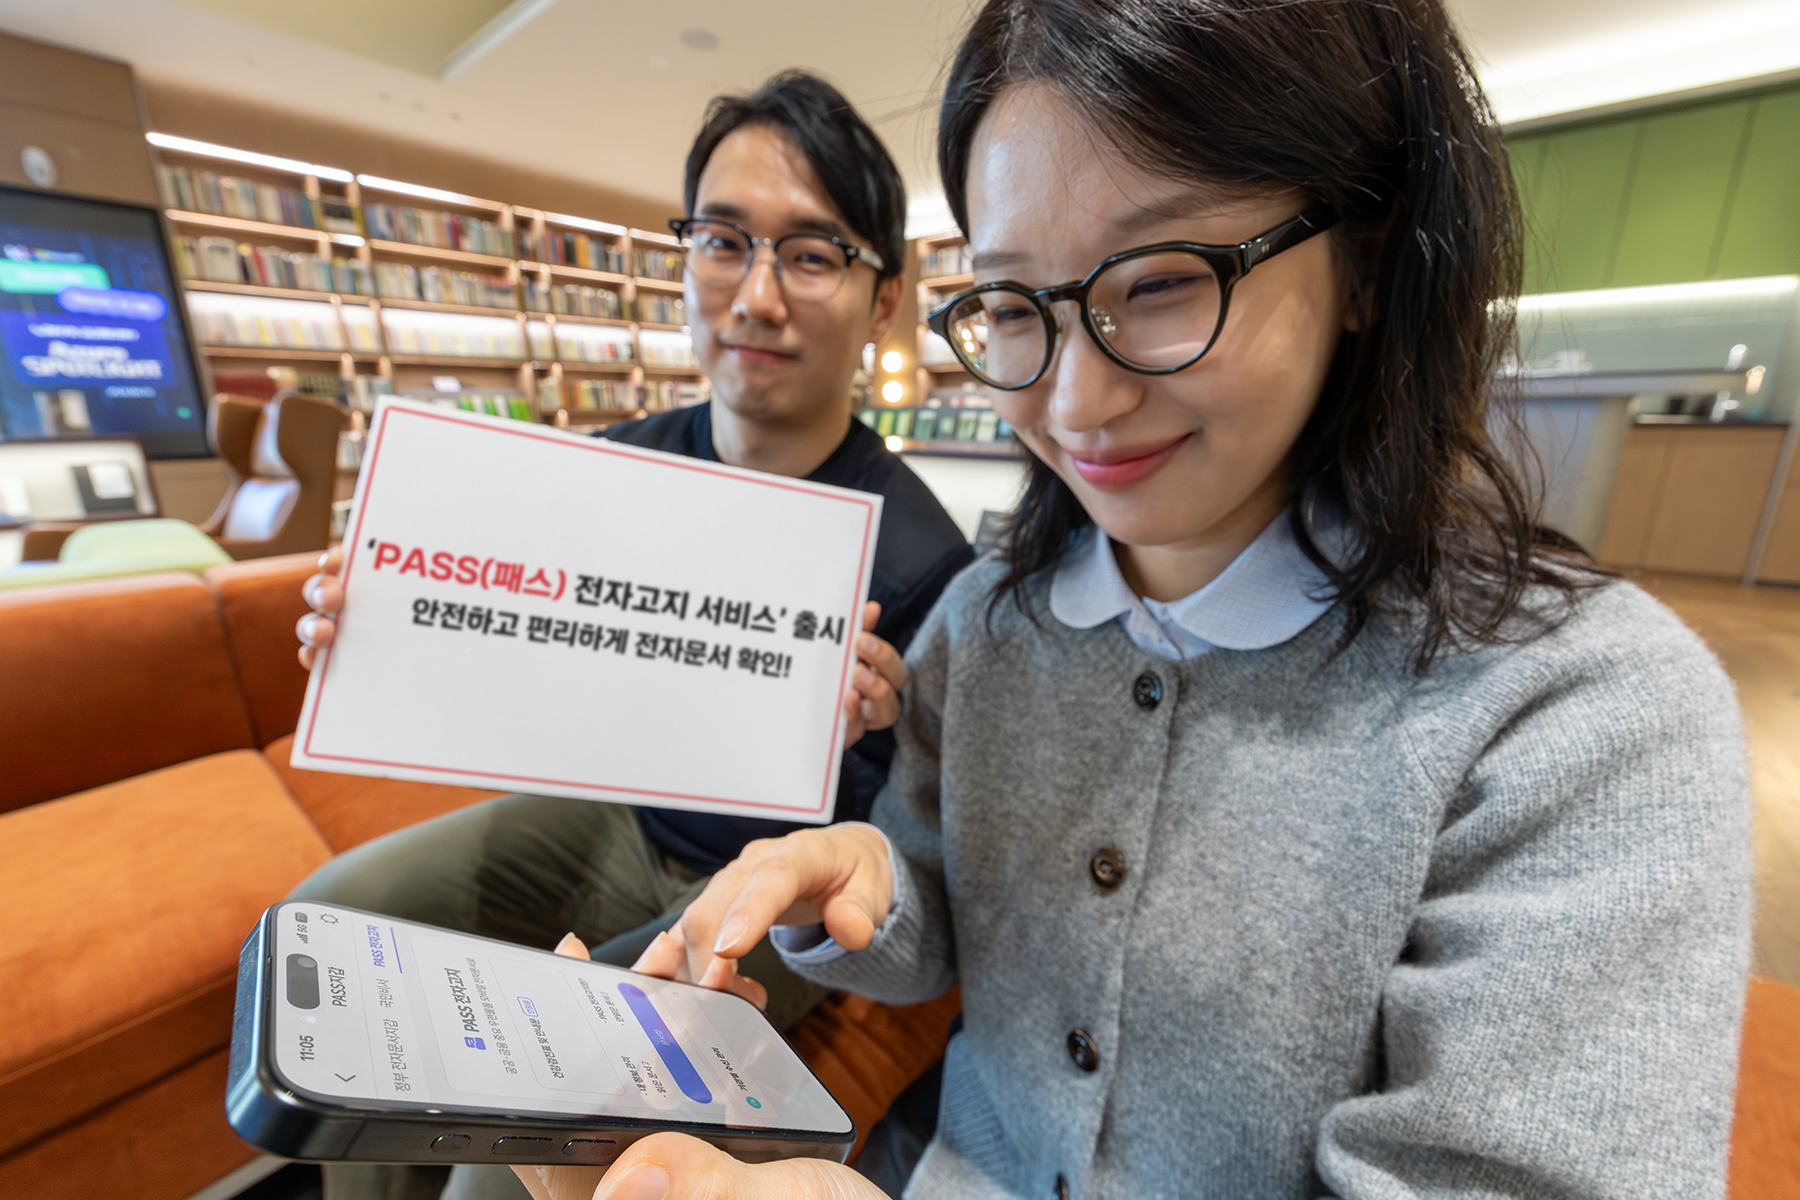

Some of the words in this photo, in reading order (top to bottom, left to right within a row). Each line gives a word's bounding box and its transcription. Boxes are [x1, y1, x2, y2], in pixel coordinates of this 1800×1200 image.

[575, 575, 689, 620] 전자고지
[794, 611, 846, 646] 출시
[413, 599, 519, 637] 안전하고
[527, 616, 629, 654] 편리하게
[636, 633, 731, 669] 전자문서
[738, 648, 791, 677] 확인!
[297, 923, 307, 933] 5G
[365, 923, 383, 950] 전자고지
[370, 948, 385, 967] PASS
[327, 965, 348, 1007] PASS지갑
[375, 977, 394, 1008] 국민비서
[443, 967, 471, 1004] 전자고지
[474, 983, 490, 1002] 모바일
[456, 1004, 480, 1032] PASS
[528, 1017, 546, 1037] 안내문
[298, 1034, 315, 1062] 11:05
[382, 1017, 407, 1071] 전자문서지갑
[540, 1044, 565, 1079] 건강검진표
[391, 1071, 412, 1092] 정부
